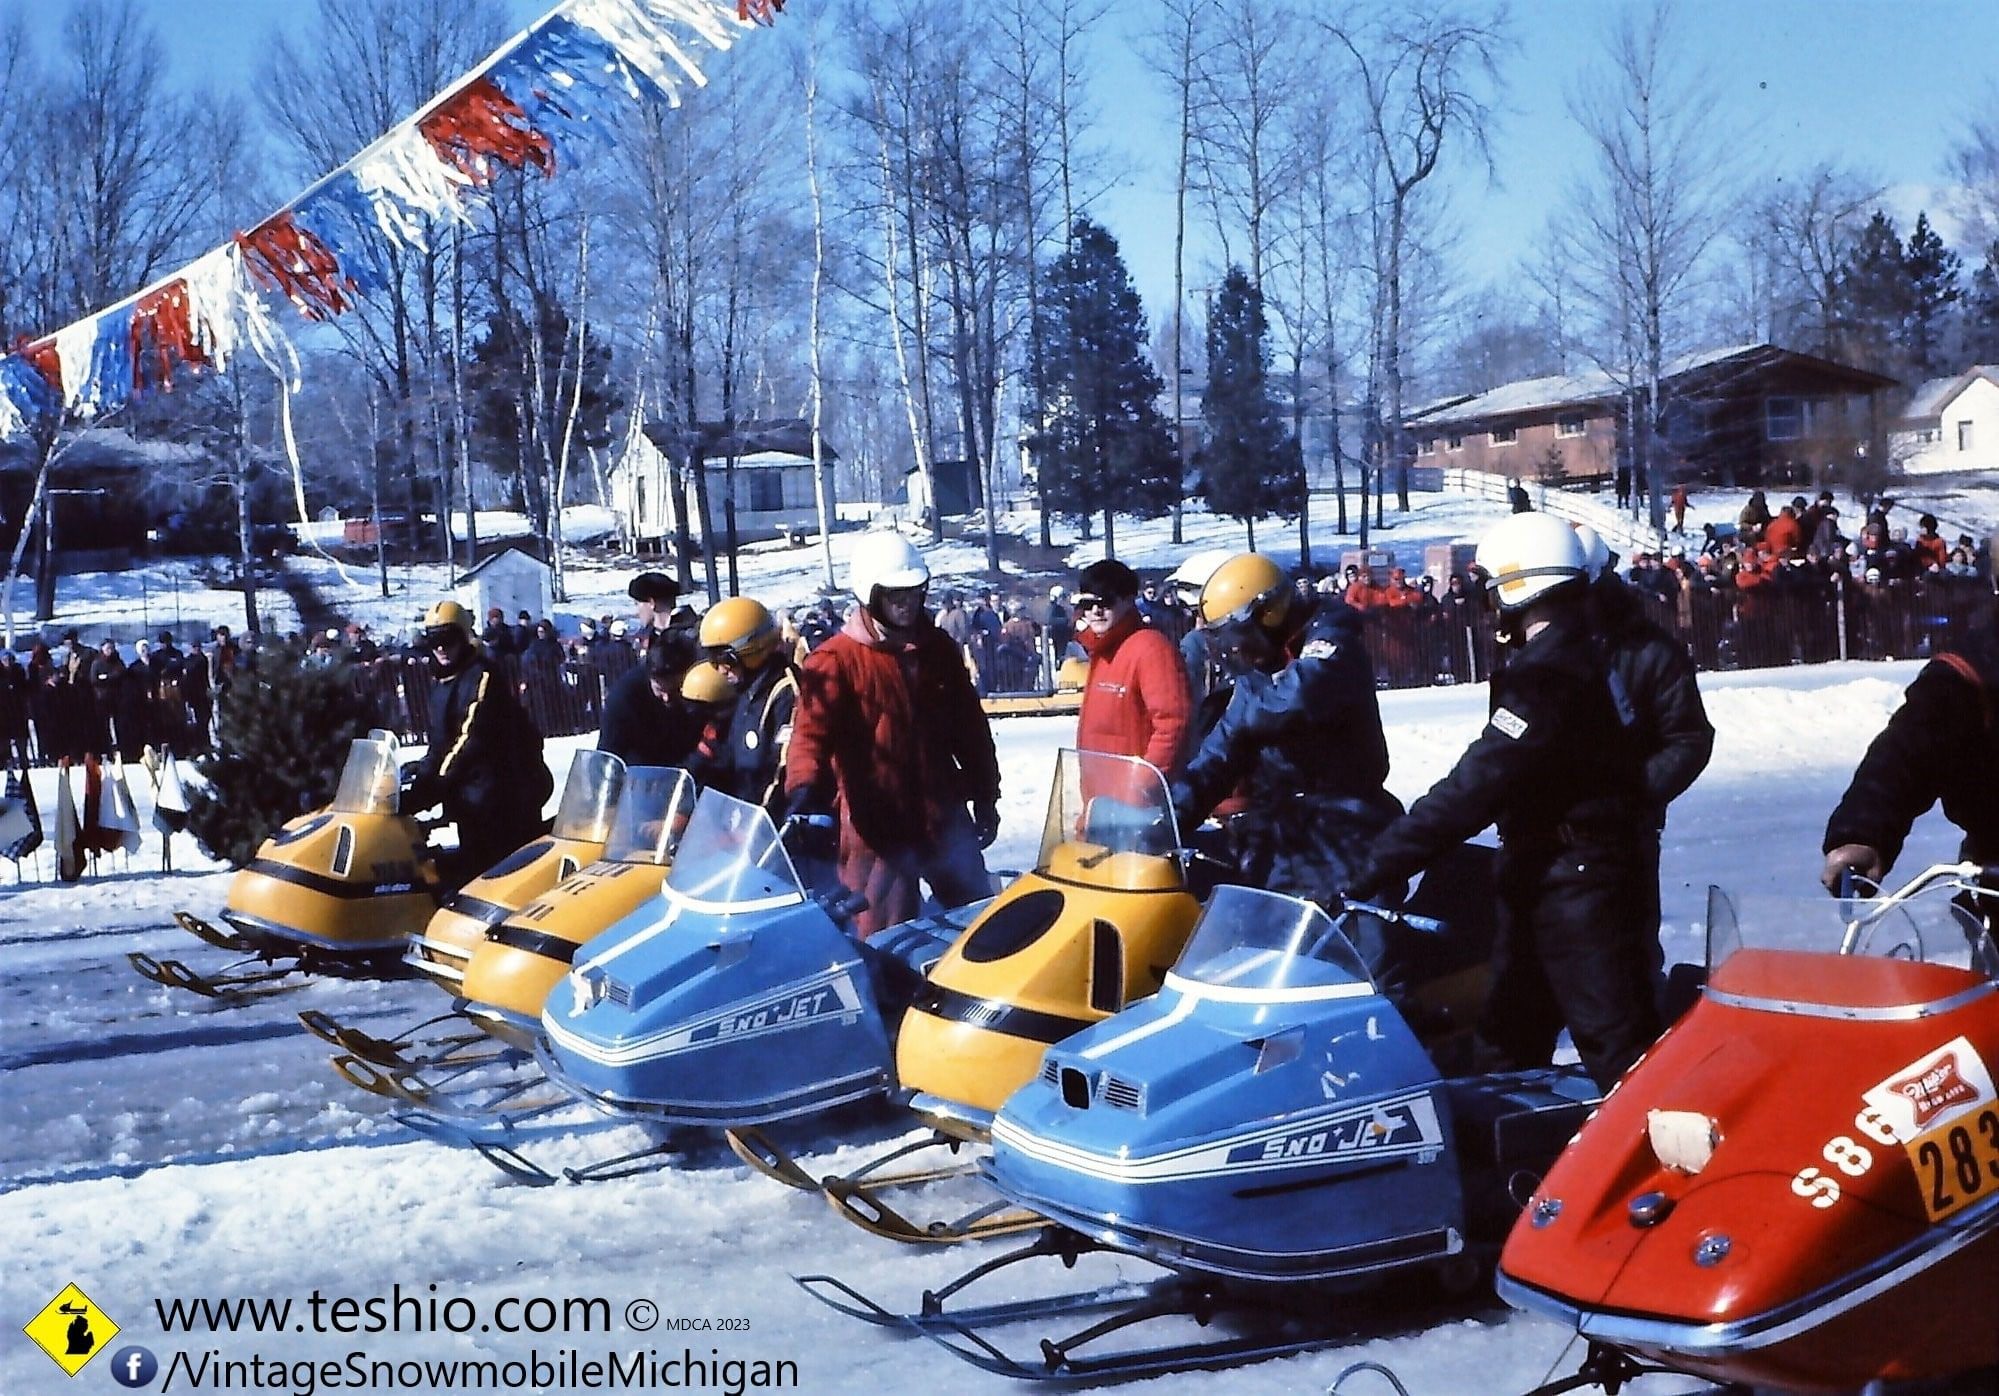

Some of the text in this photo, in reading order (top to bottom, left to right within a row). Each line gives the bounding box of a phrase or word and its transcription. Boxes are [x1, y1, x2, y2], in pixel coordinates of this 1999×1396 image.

[717, 991, 828, 1036] SNO JET
[1261, 1131, 1328, 1160] SNO
